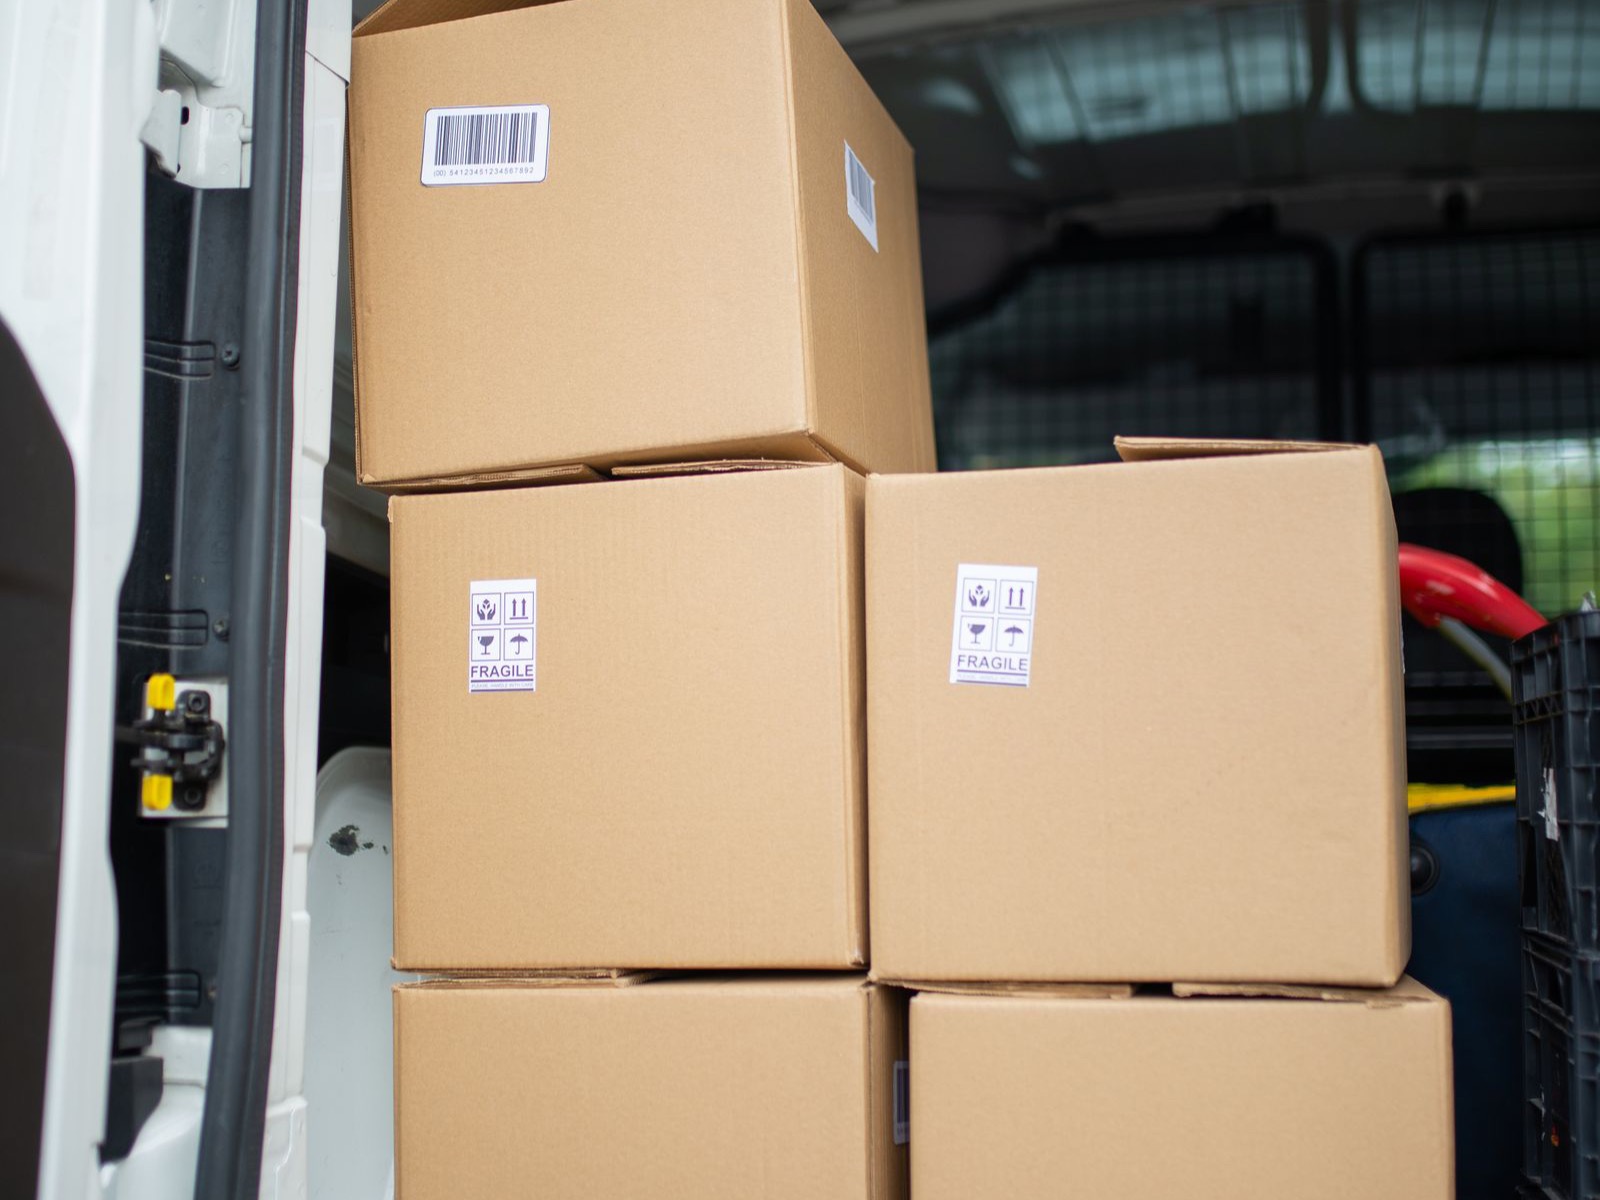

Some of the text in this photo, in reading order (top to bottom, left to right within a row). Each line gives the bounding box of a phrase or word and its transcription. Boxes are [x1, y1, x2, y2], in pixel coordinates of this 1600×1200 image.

[433, 169, 447, 177] (00)
[957, 654, 1028, 671] FRAGILE
[470, 664, 534, 678] FRAGILE
